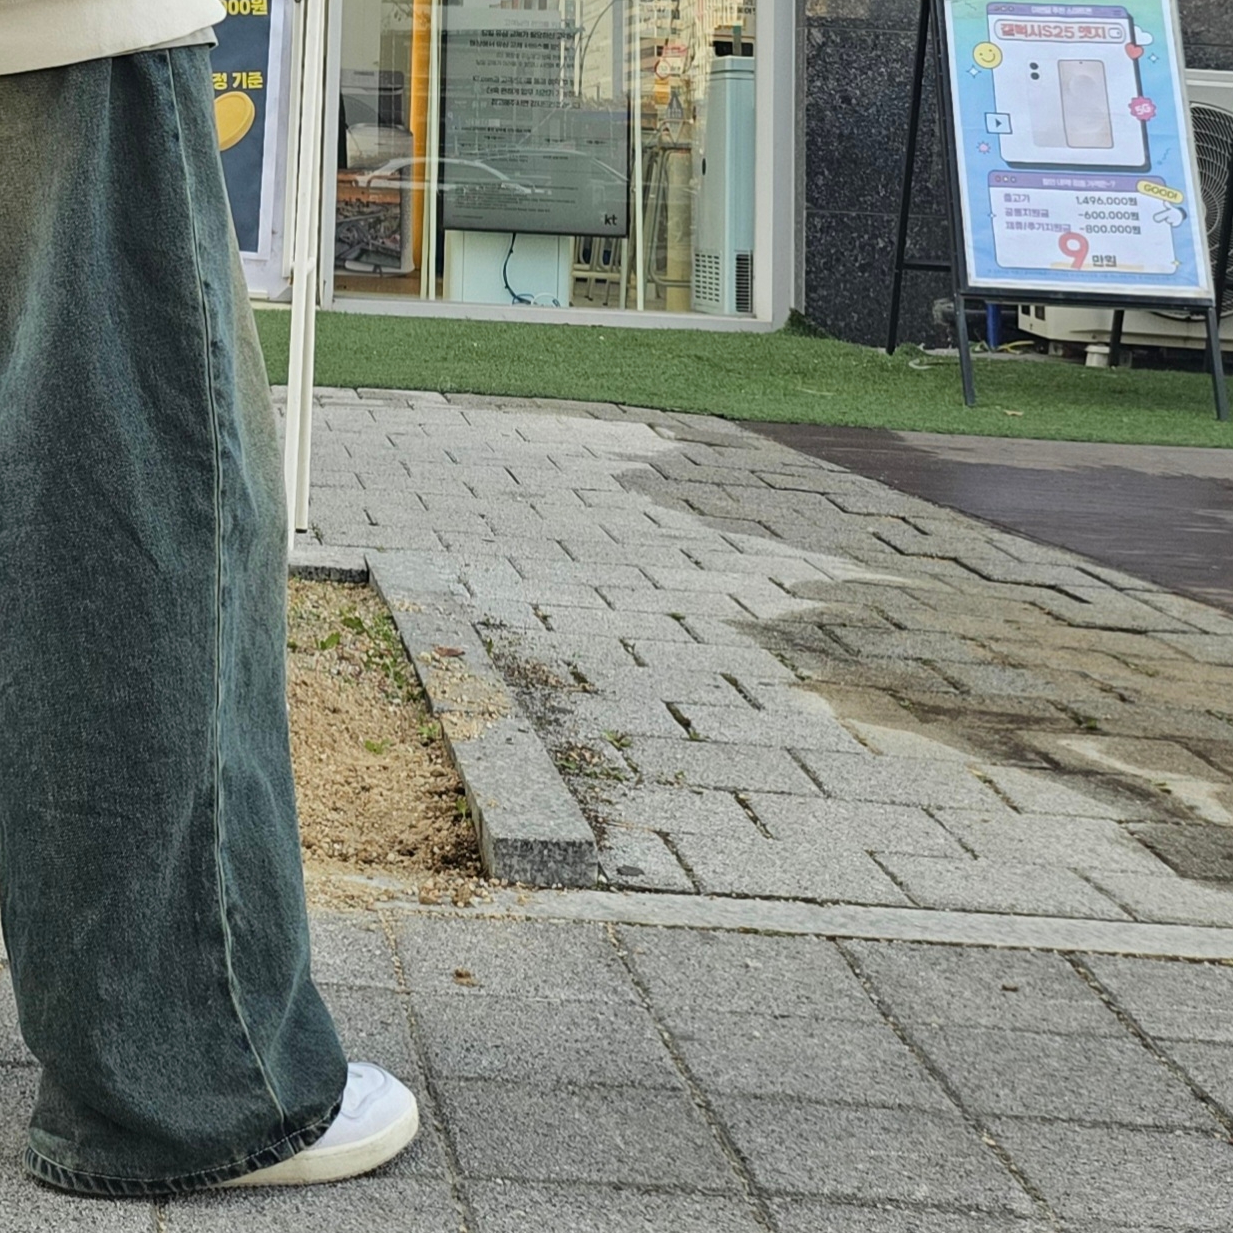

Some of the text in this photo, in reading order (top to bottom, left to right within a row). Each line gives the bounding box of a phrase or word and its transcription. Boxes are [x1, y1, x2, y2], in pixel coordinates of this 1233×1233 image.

[231, 71, 264, 90] 기준
[1143, 183, 1178, 200] GOOD!
[603, 213, 618, 226] kt
[1057, 231, 1118, 271] 9 만원
